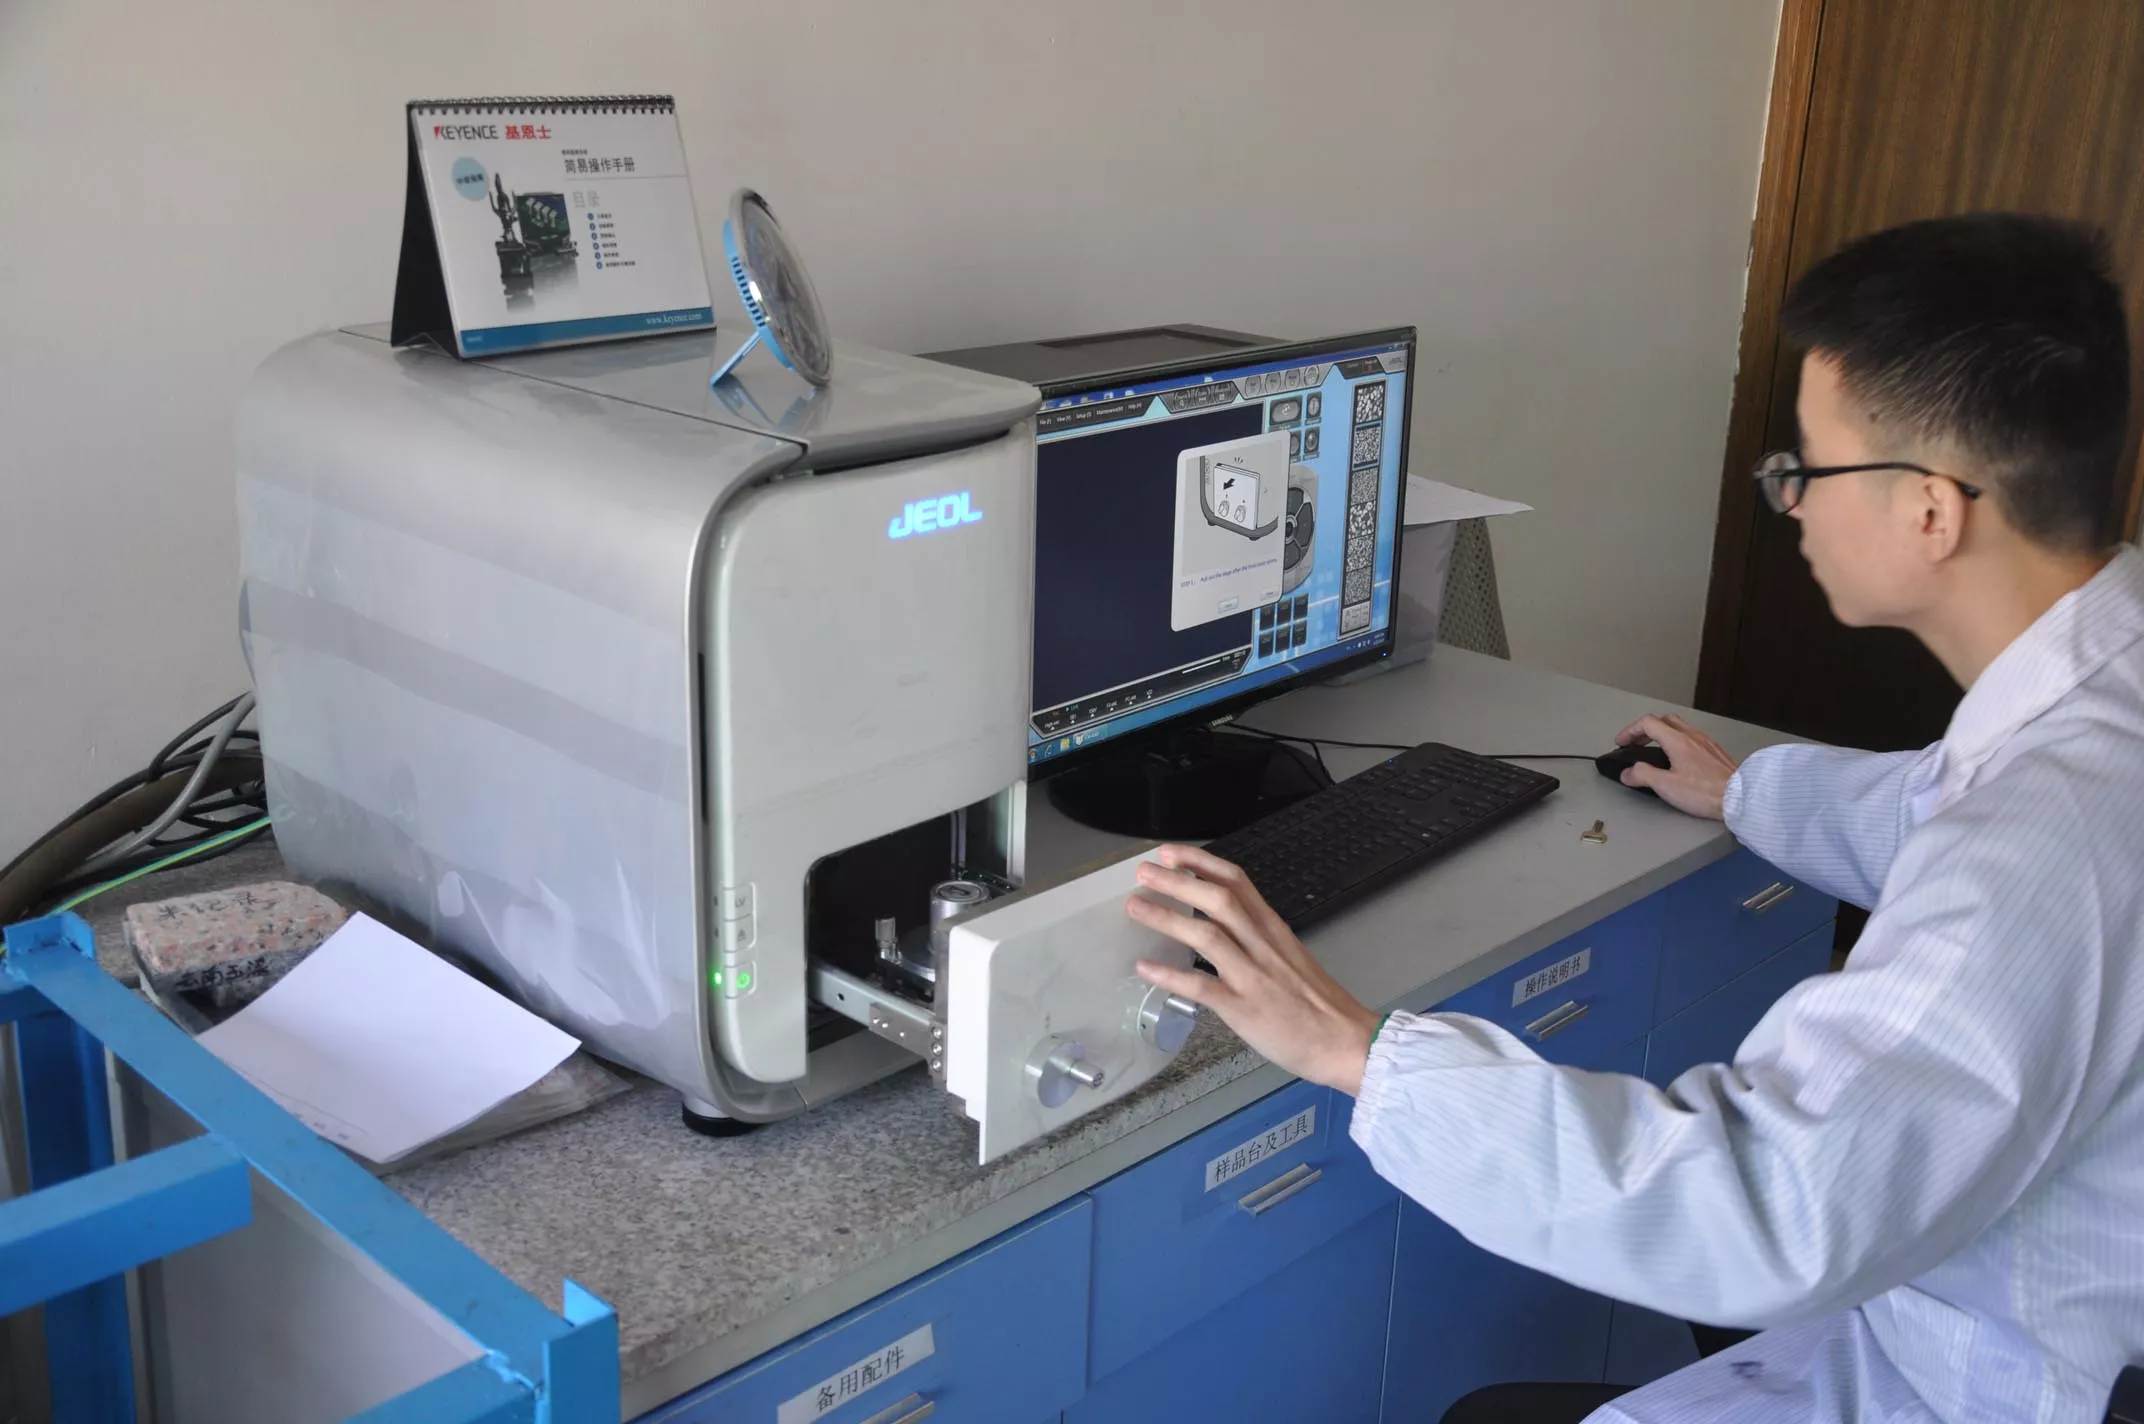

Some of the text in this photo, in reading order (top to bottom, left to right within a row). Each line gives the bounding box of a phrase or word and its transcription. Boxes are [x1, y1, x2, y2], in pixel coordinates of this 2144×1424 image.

[433, 124, 552, 140] KEYENCE 基恩士
[564, 156, 636, 174] 简易操作手册
[888, 490, 984, 540] JEOL
[1525, 955, 1581, 998] 操作说明书
[1215, 1114, 1308, 1182] 样品台及工具
[816, 1345, 905, 1413] 备用配件
